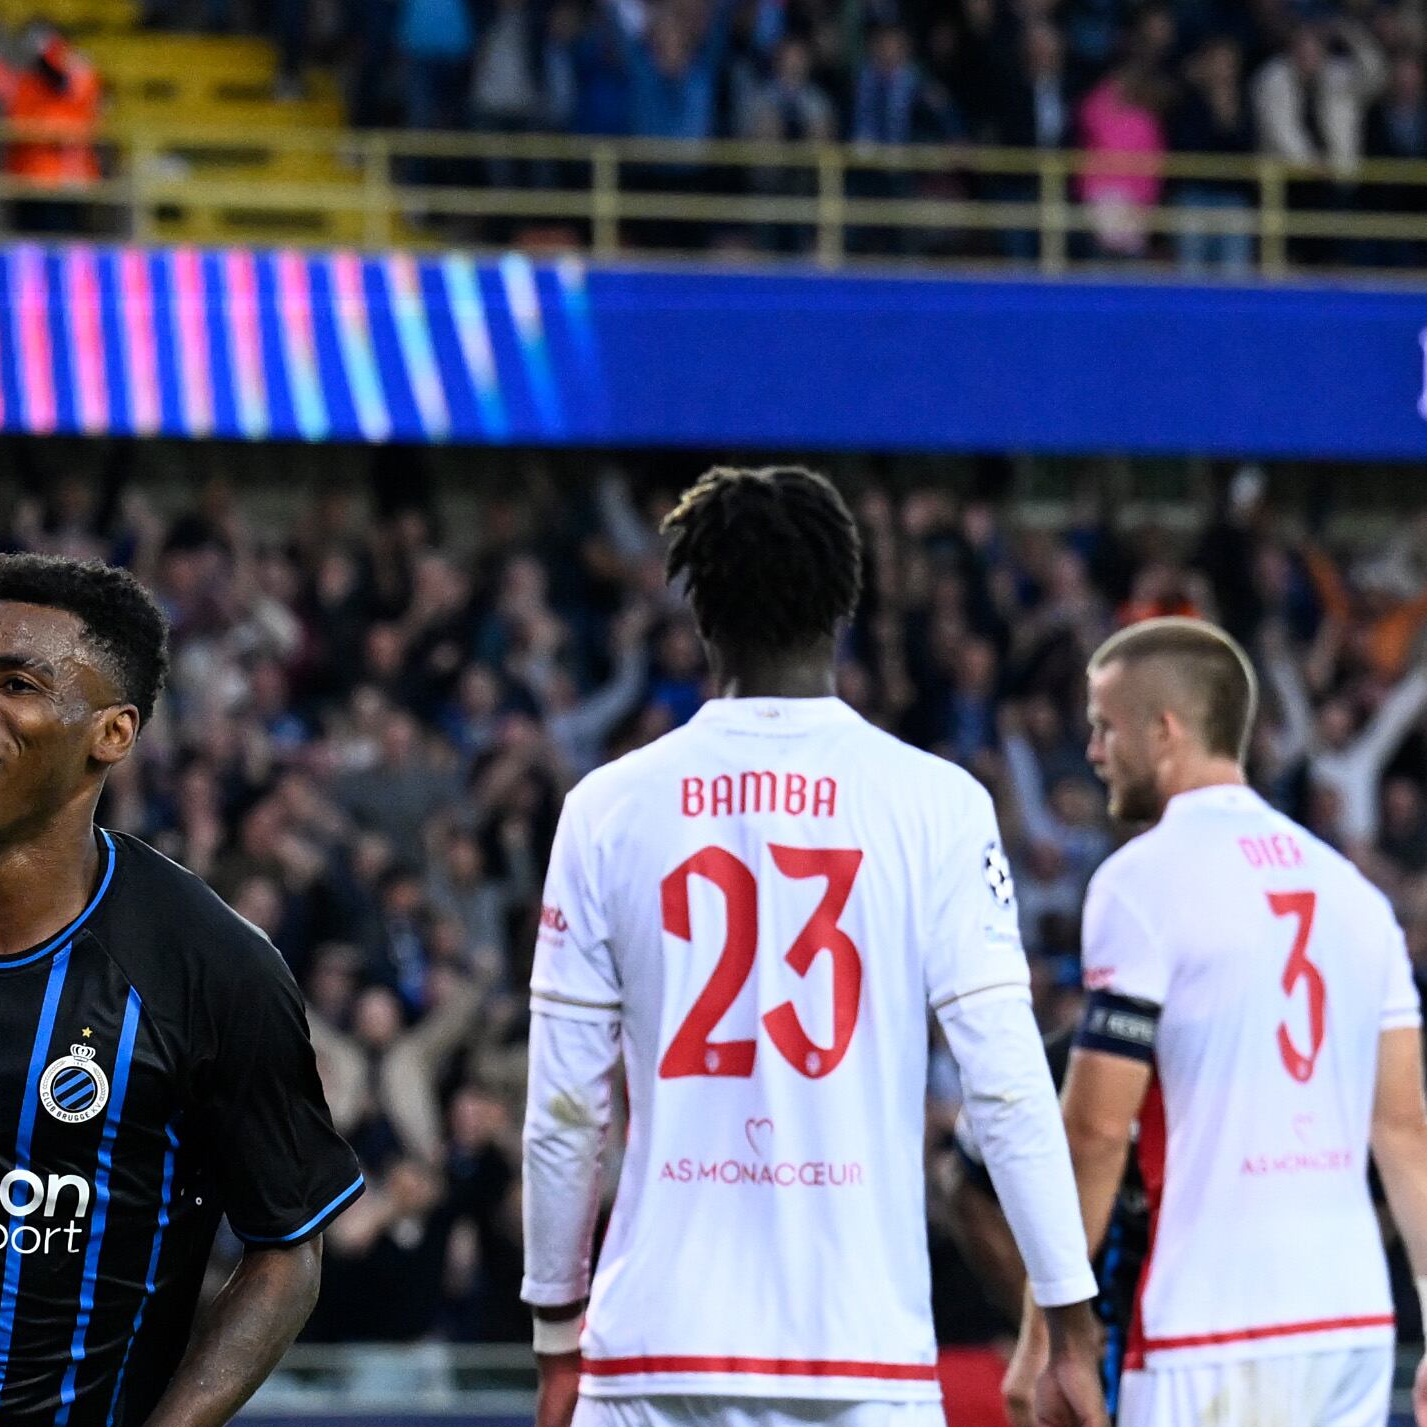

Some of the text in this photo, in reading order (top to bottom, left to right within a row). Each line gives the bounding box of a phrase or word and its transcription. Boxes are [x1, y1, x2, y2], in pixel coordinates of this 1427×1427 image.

[681, 770, 838, 818] BAMBA
[659, 842, 864, 1079] 23
[1265, 889, 1327, 1085] 3
[42, 1091, 56, 1112] CLUB
[56, 1111, 90, 1121] BRUGGE
